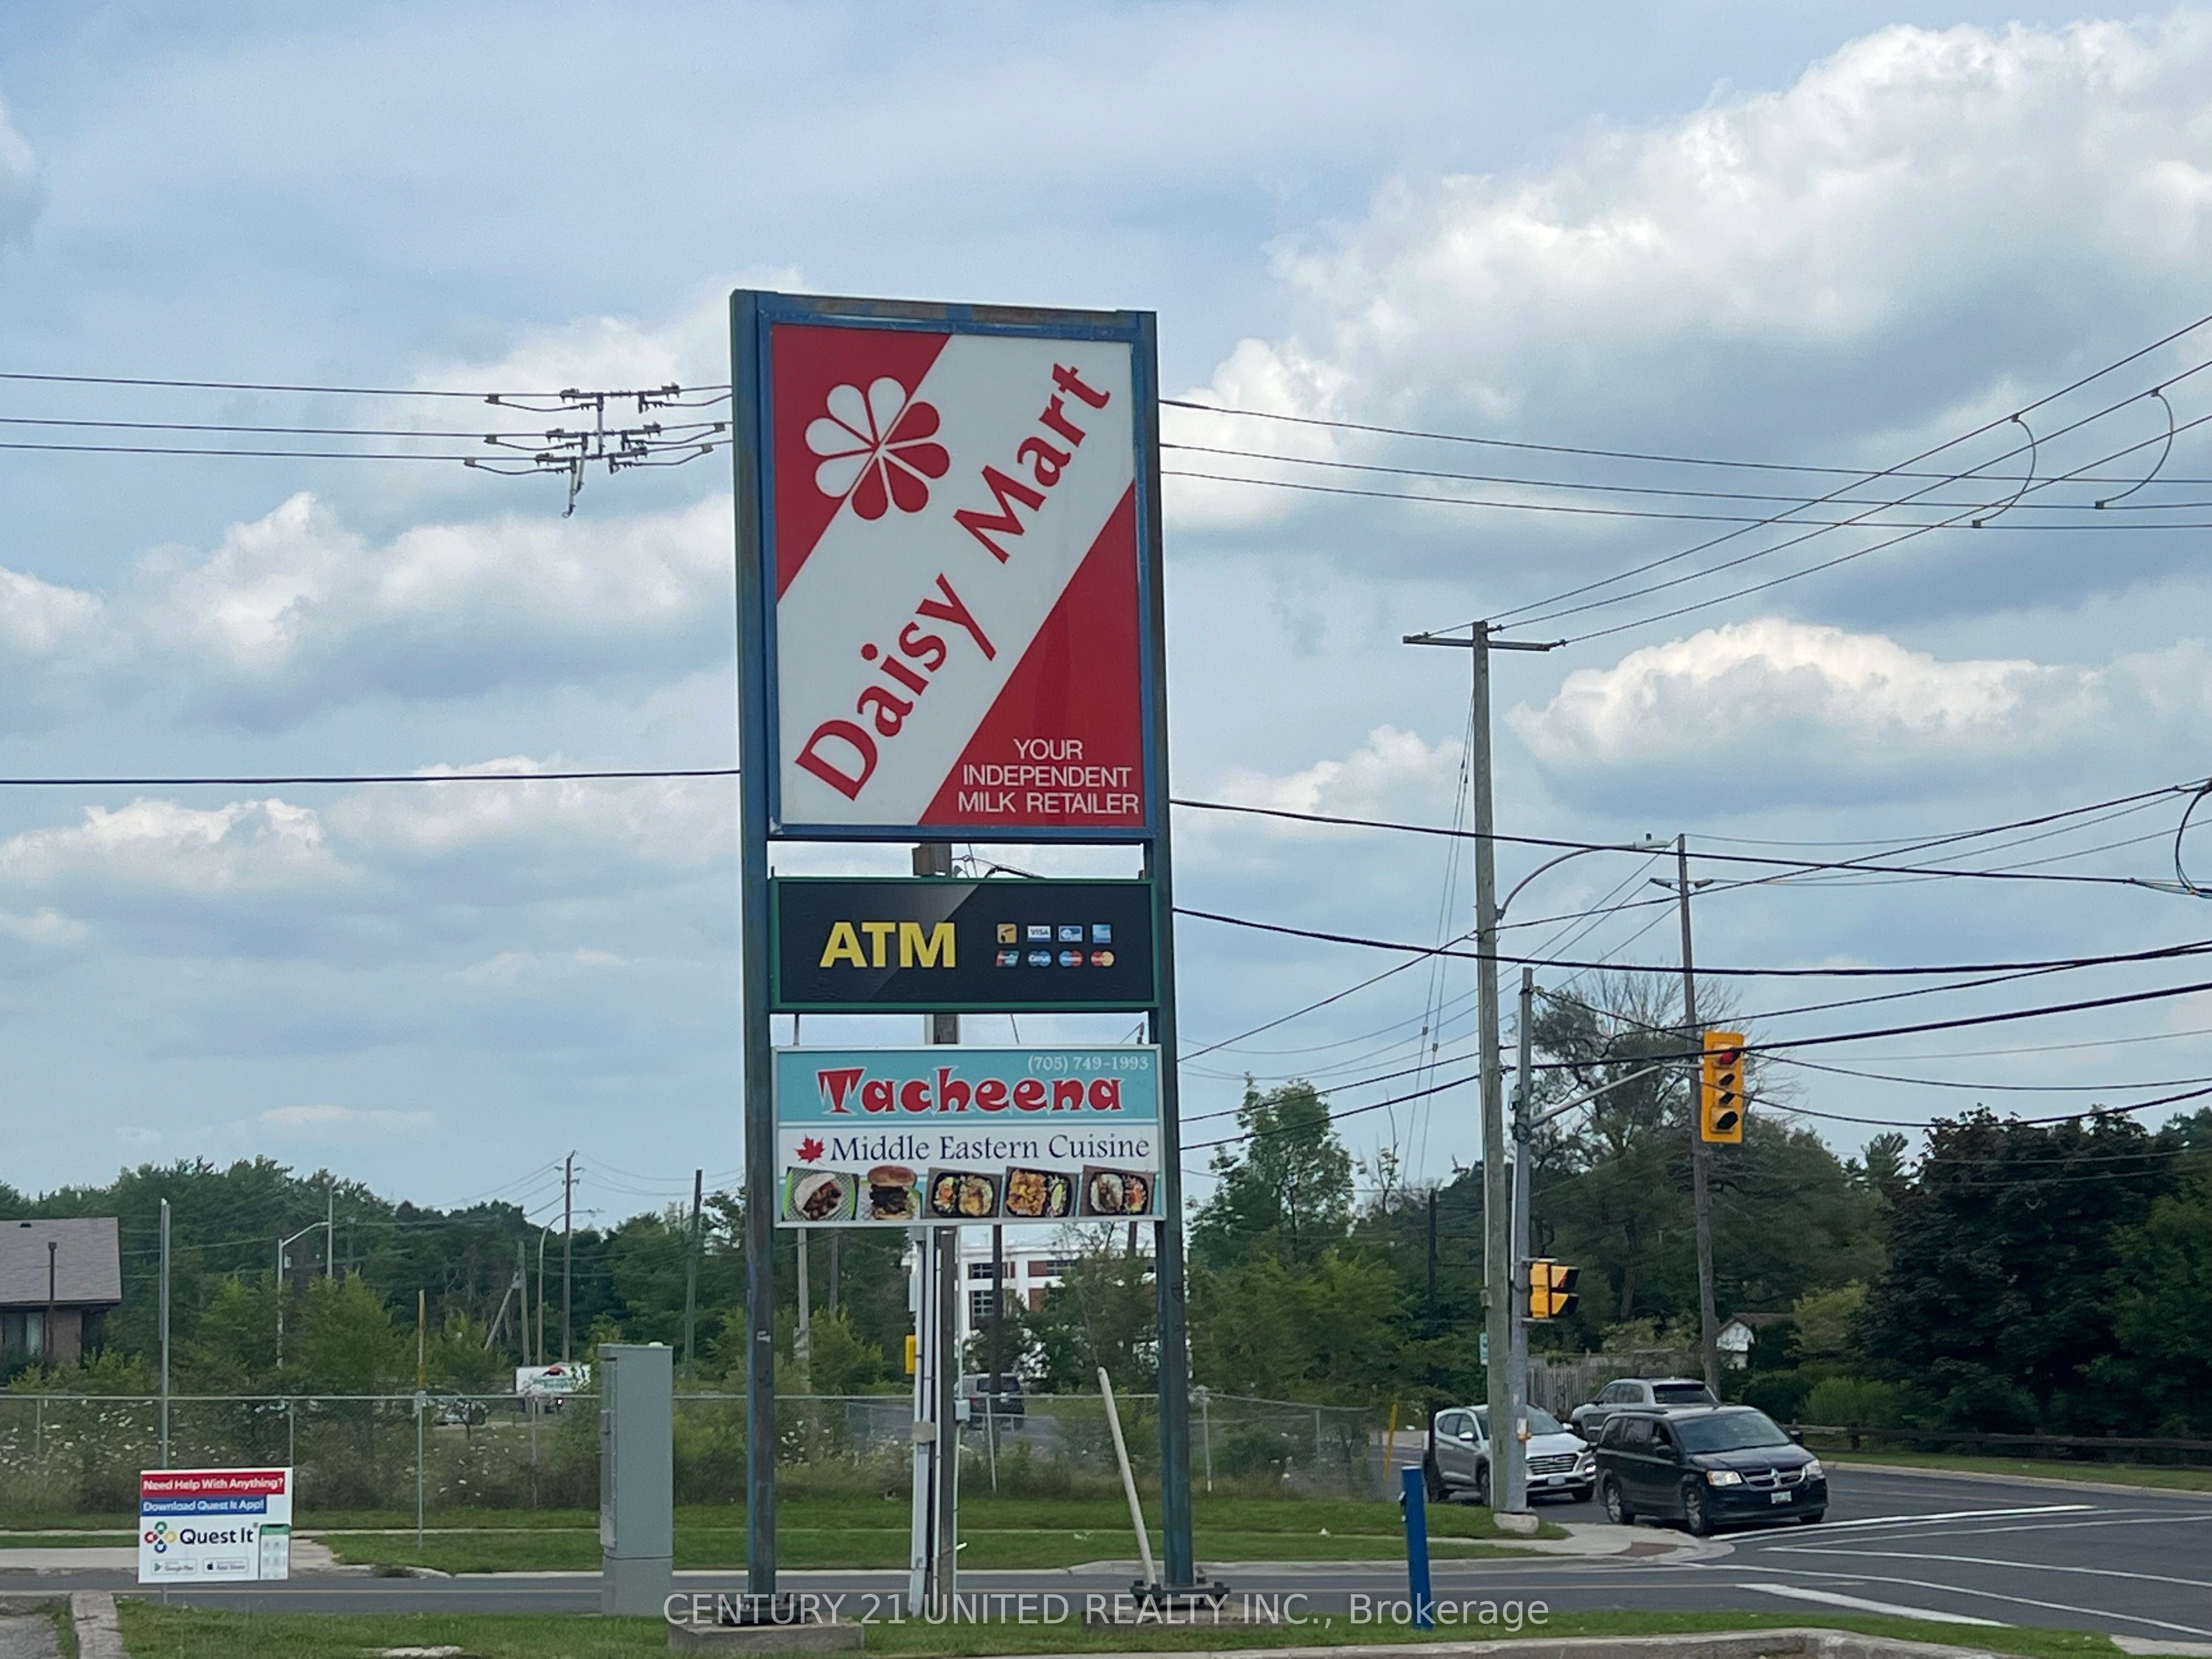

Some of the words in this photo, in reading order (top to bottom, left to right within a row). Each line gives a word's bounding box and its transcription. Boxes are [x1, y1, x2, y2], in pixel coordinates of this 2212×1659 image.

[795, 573, 996, 801] Daisy
[953, 363, 1111, 565] Mart
[1014, 738, 1083, 760] YOUR
[963, 764, 1133, 788] INDEPENDENT
[958, 791, 1016, 813] MILK
[1026, 792, 1139, 814] RETAILER
[819, 921, 957, 968] ATM
[1027, 1054, 1069, 1075] (705)
[1073, 1056, 1149, 1070] 749-1993
[816, 1067, 1122, 1115] Tacheena
[830, 1135, 930, 1161] Middle
[939, 1135, 1040, 1160] Eastern
[1048, 1132, 1150, 1159] Cuisine
[143, 1480, 173, 1491] Need
[175, 1480, 200, 1491] Help
[202, 1479, 228, 1489] With
[229, 1477, 284, 1490] Anything?
[143, 1500, 196, 1512] Download
[198, 1500, 229, 1511] Quest
[239, 1499, 264, 1511] App!
[179, 1528, 237, 1545] Quest
[240, 1527, 253, 1543] It
